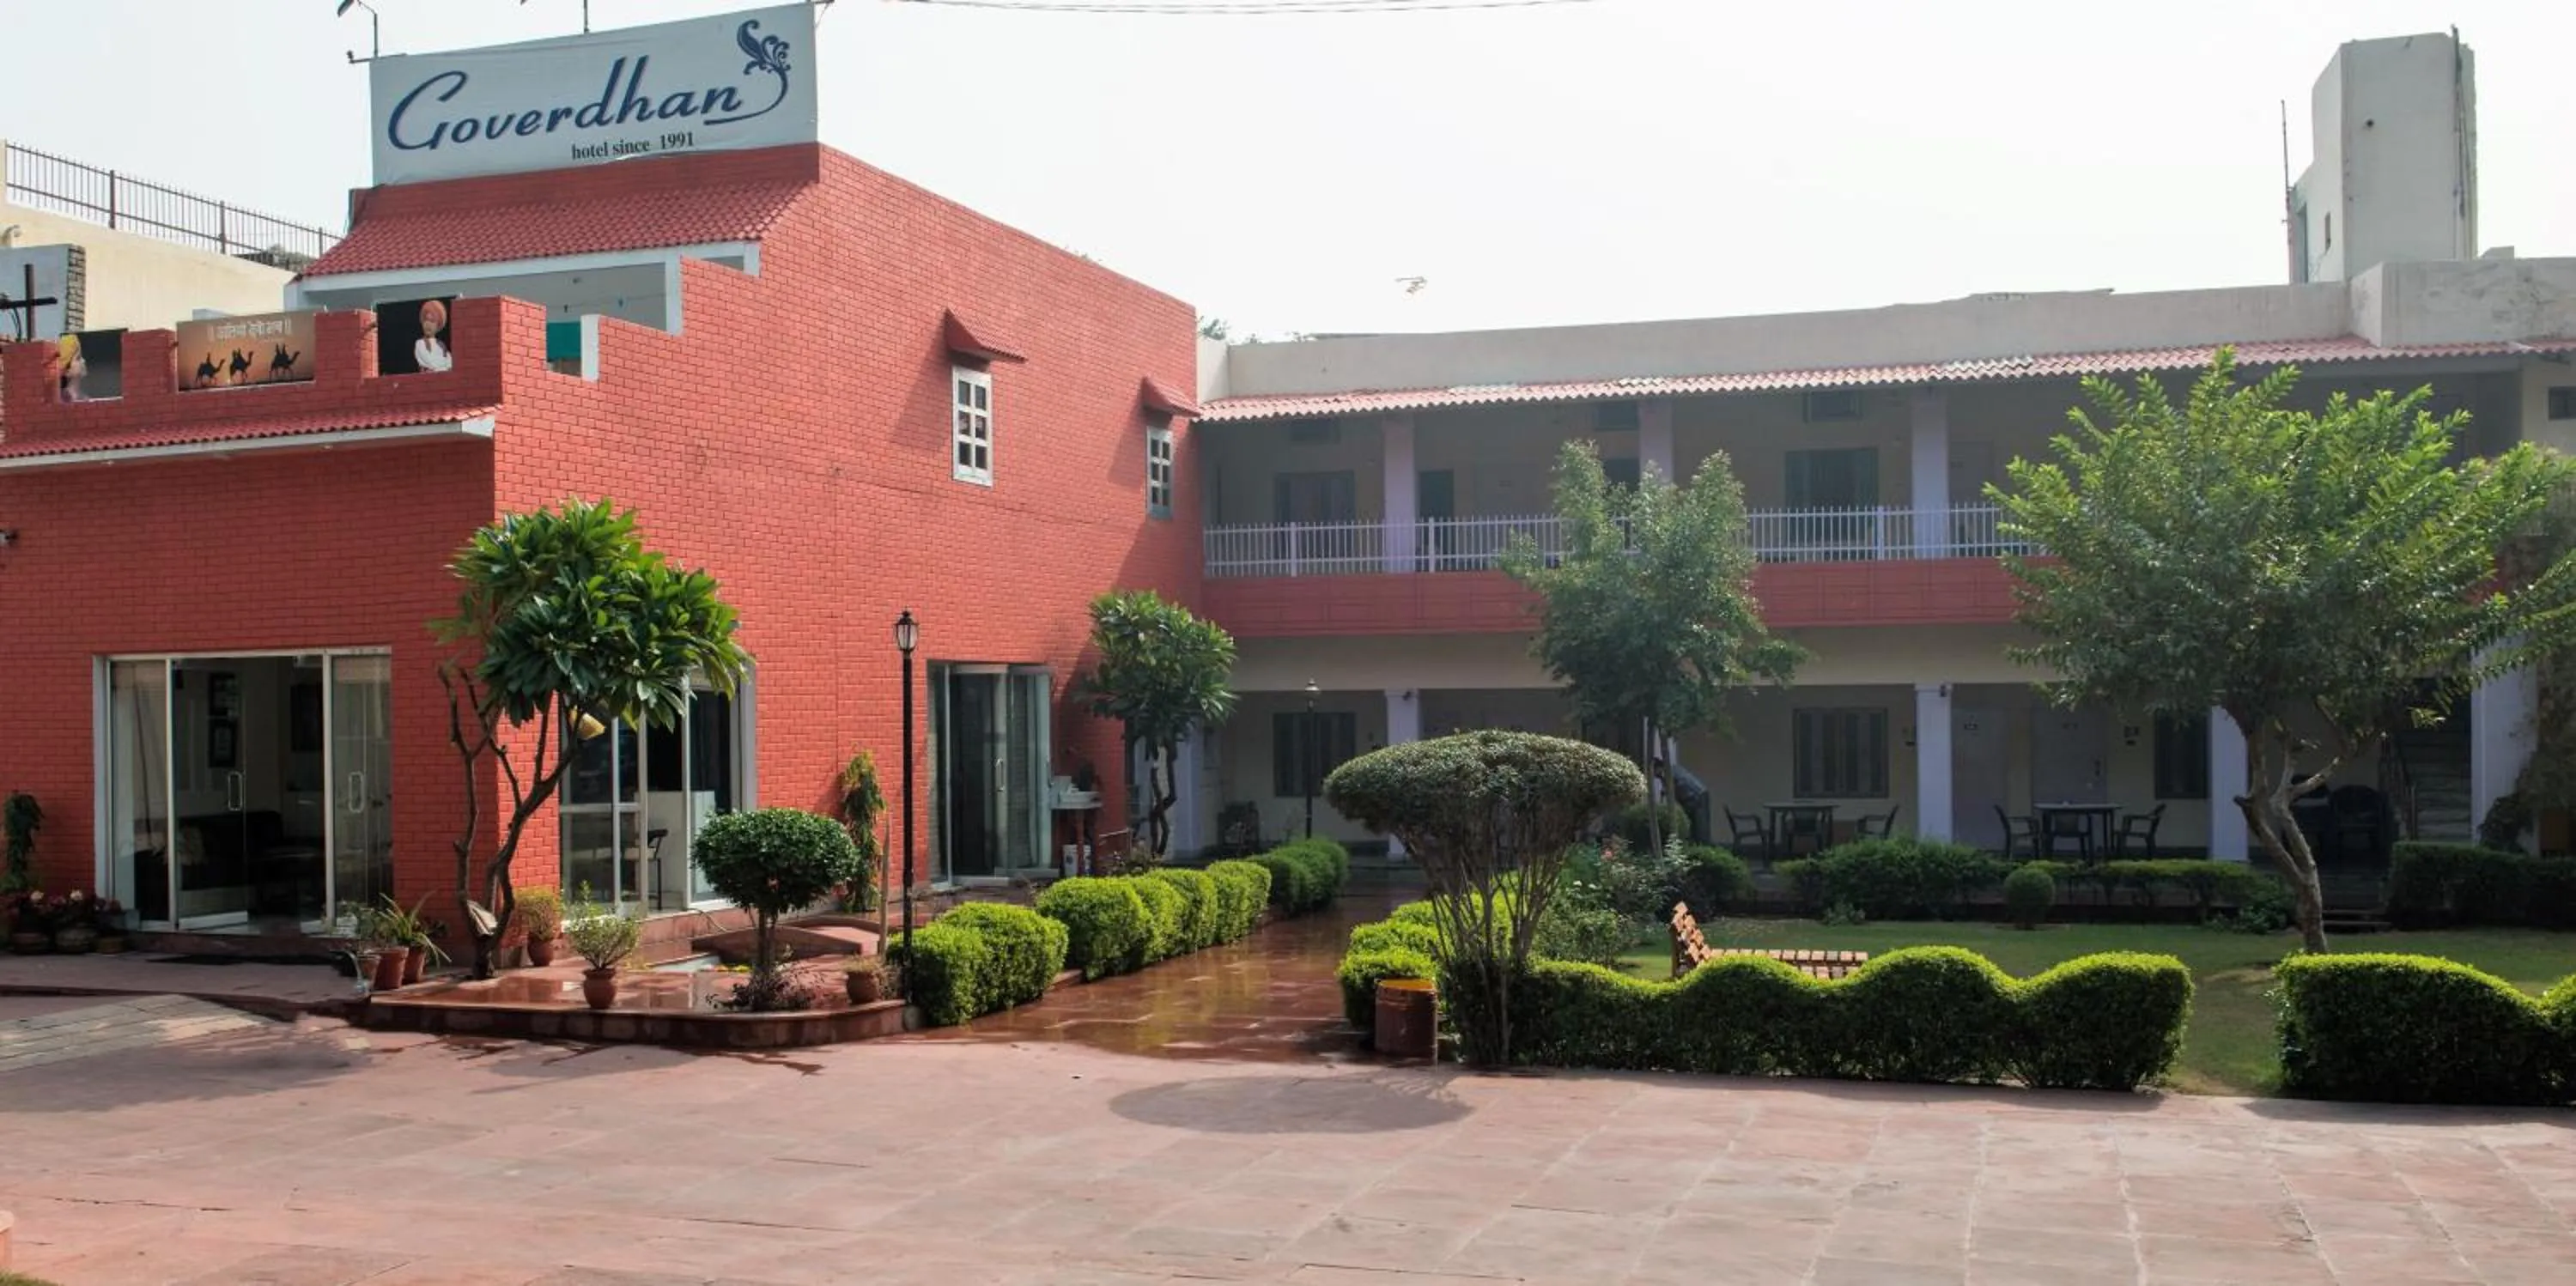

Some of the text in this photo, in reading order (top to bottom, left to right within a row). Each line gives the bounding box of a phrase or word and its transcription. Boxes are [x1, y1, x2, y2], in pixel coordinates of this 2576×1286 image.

[387, 54, 742, 150] Goverdhan
[571, 130, 694, 161] hotel since 1991
